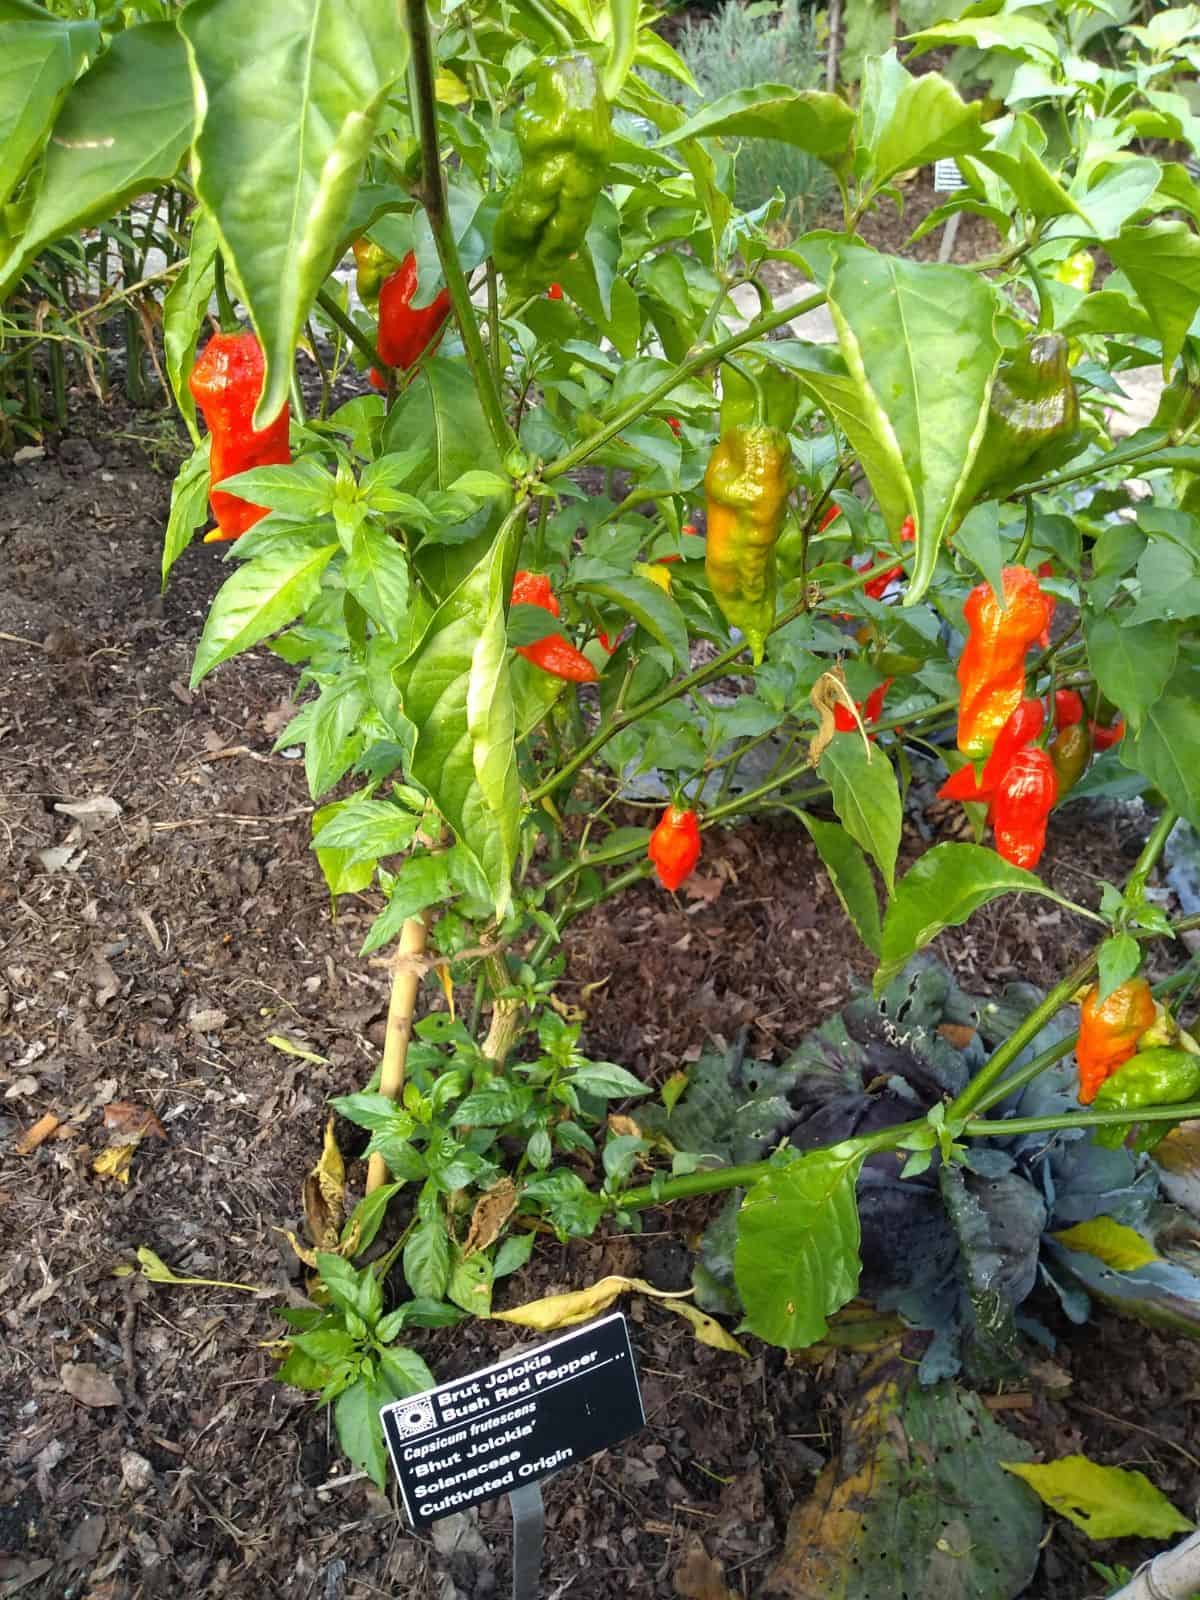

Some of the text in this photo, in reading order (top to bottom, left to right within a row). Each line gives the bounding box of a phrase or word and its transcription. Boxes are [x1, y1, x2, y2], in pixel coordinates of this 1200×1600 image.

[438, 1354, 552, 1407] Brut Jolokia
[441, 1349, 598, 1423] Bush Red Pepper
[404, 1402, 537, 1461] Capsicum frutescens
[414, 1450, 521, 1498] Solanaceae
[419, 1447, 573, 1517] Cultivated Origin
